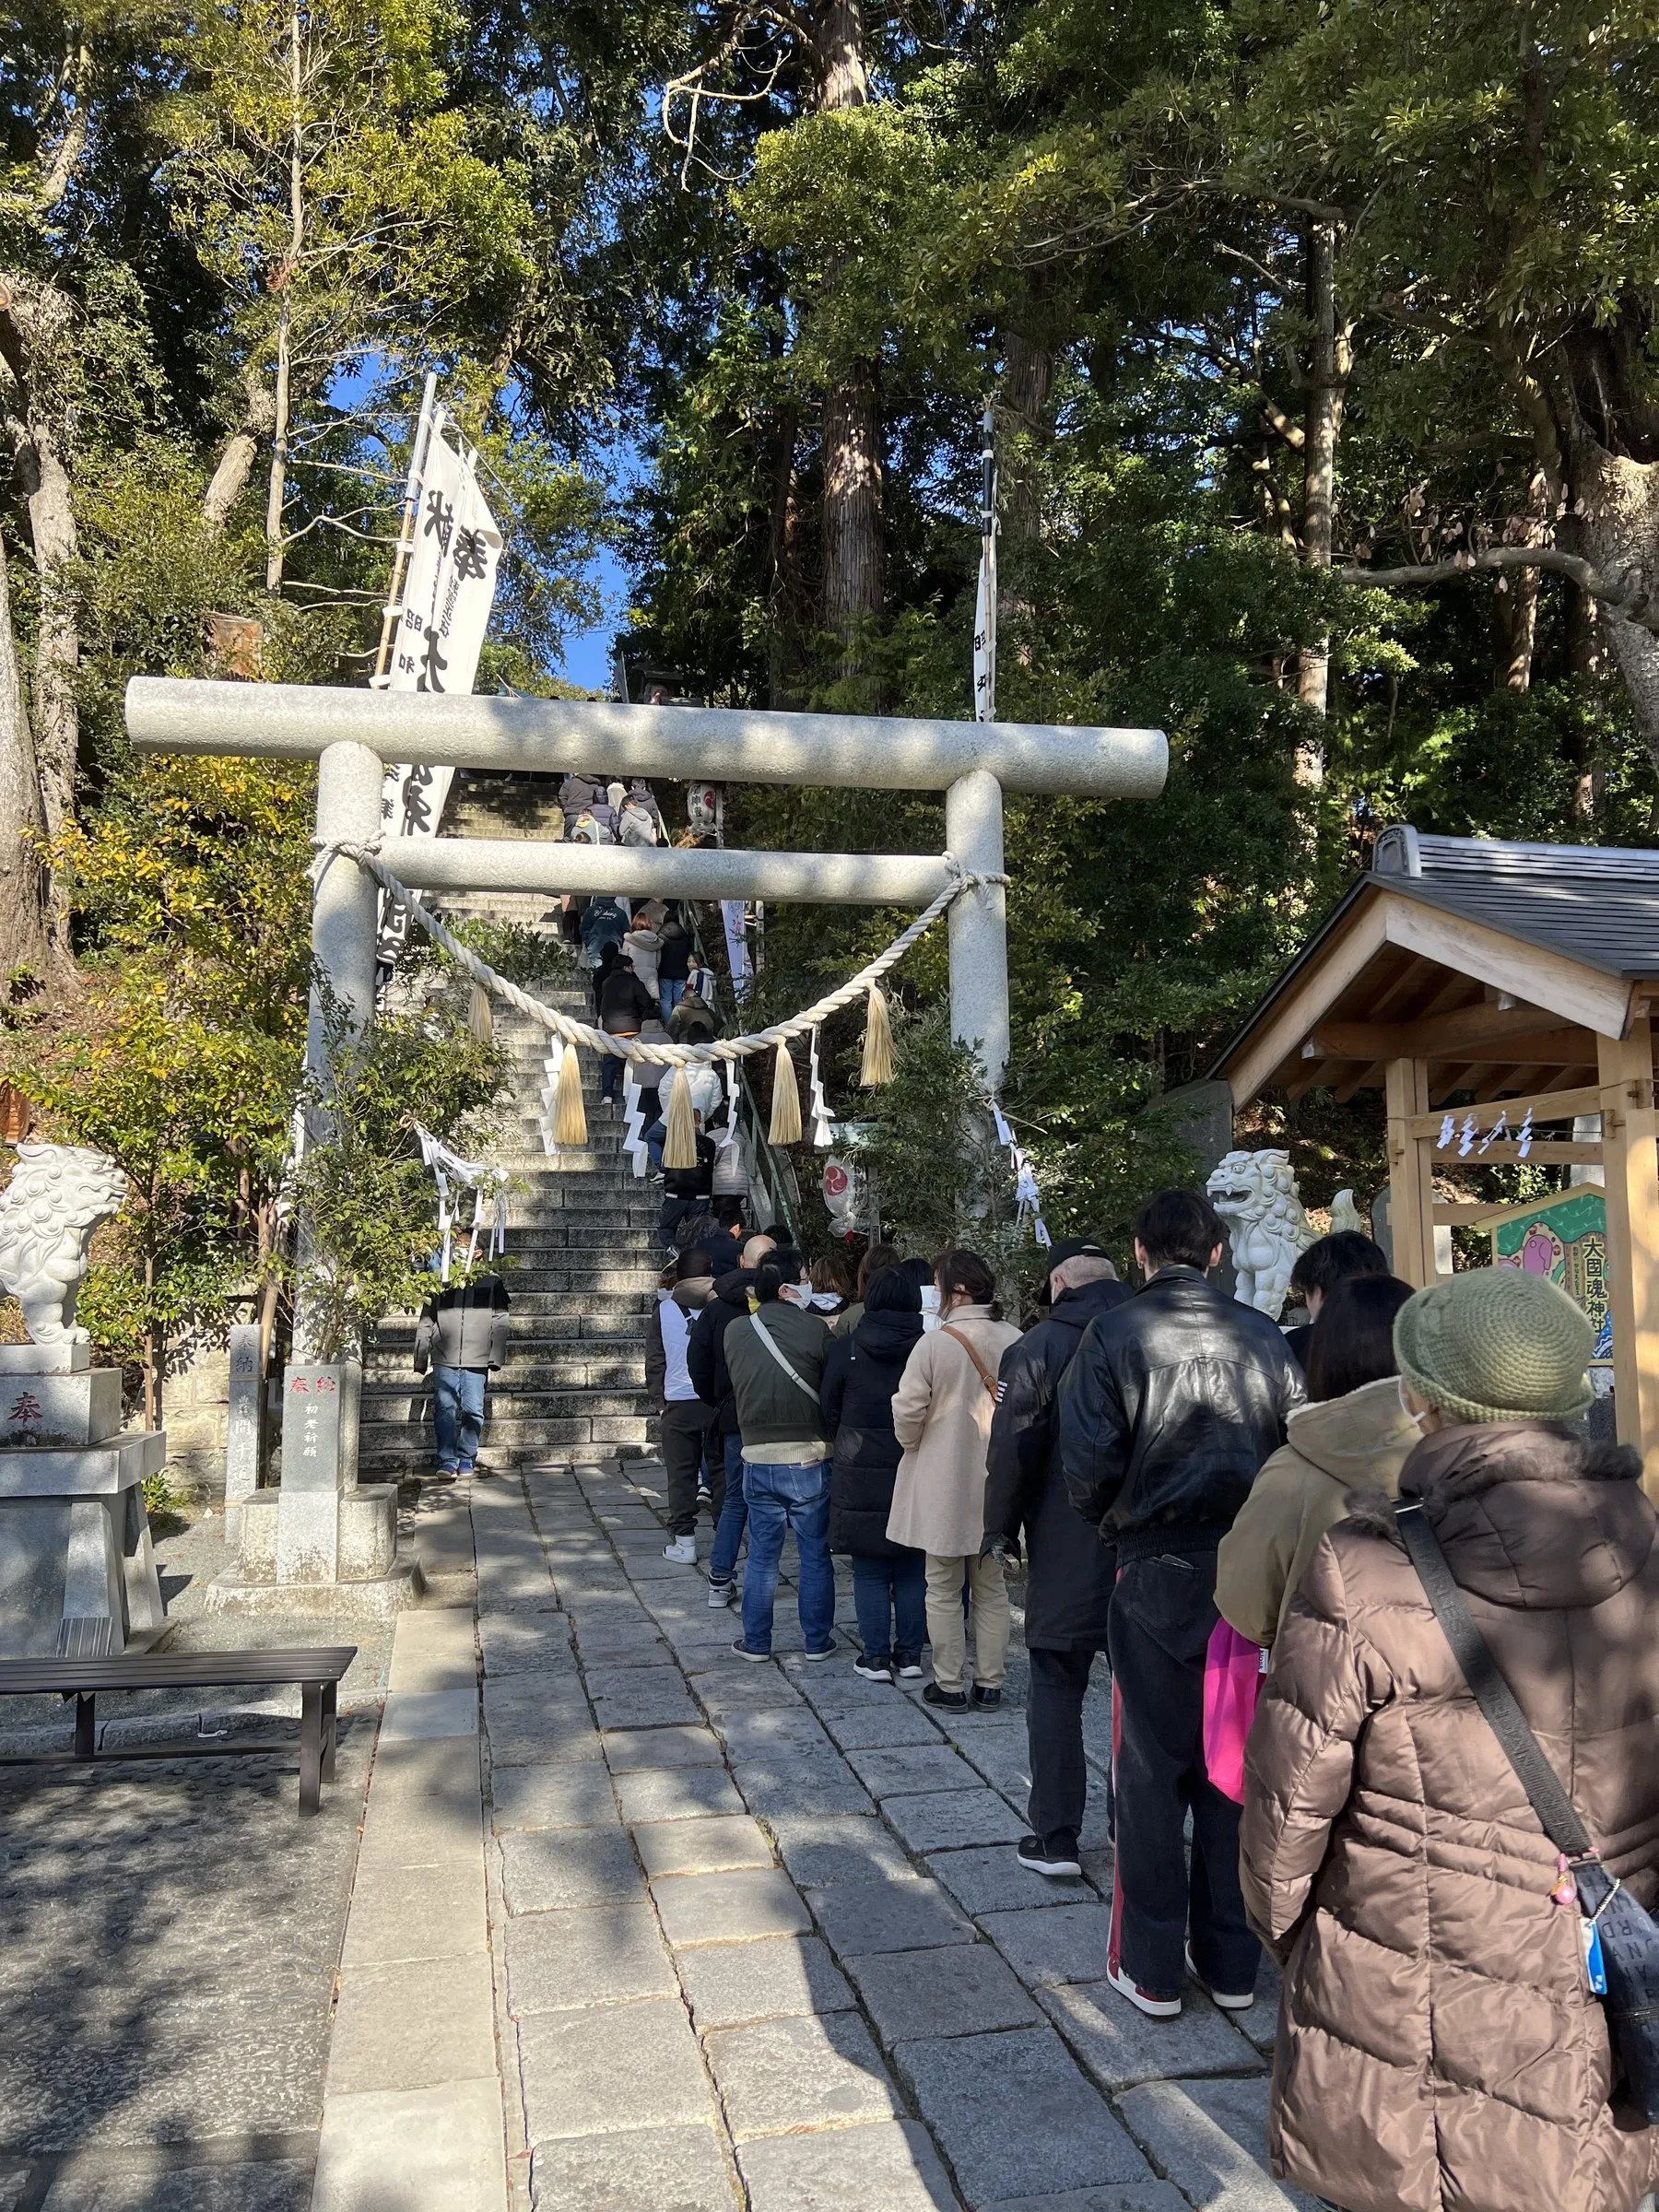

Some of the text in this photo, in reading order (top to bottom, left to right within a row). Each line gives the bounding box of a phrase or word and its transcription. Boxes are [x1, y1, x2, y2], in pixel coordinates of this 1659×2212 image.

[236, 1334, 255, 1372] 奉納
[289, 1376, 335, 1394] 奉納
[7, 1392, 43, 1426] 奉
[302, 1403, 319, 1458] 初老祈願
